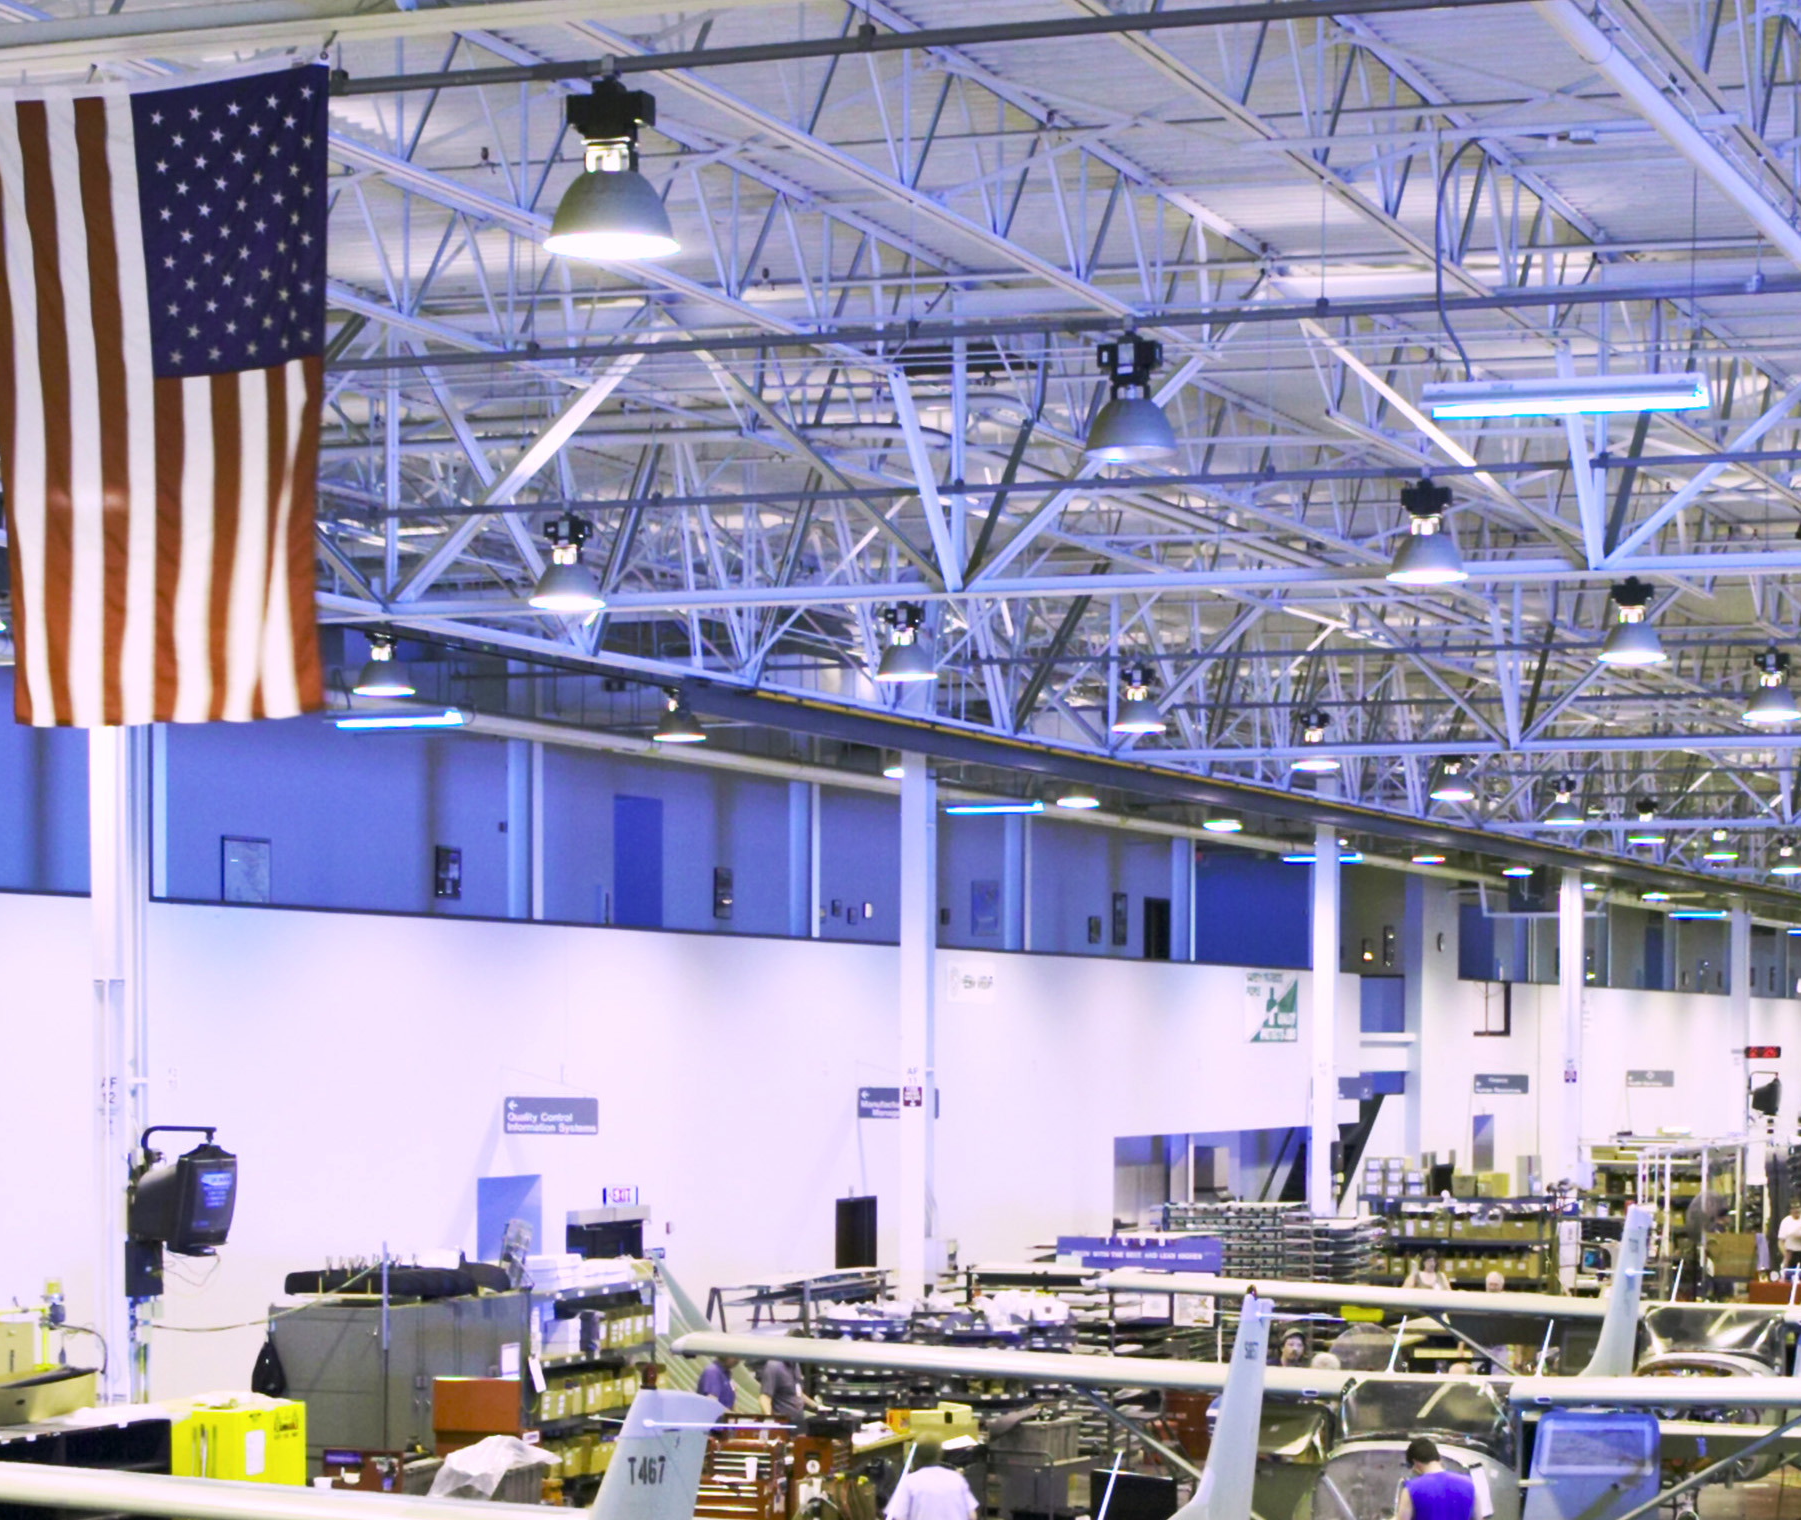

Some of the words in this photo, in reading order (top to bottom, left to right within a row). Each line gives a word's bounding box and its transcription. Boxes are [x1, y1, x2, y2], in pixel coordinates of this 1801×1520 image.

[507, 1111, 537, 1124] Quality
[540, 1111, 574, 1122] Control
[507, 1122, 557, 1132] Information
[558, 1122, 597, 1135] Systems
[612, 1188, 631, 1203] EXIT
[627, 1455, 666, 1486] T467
